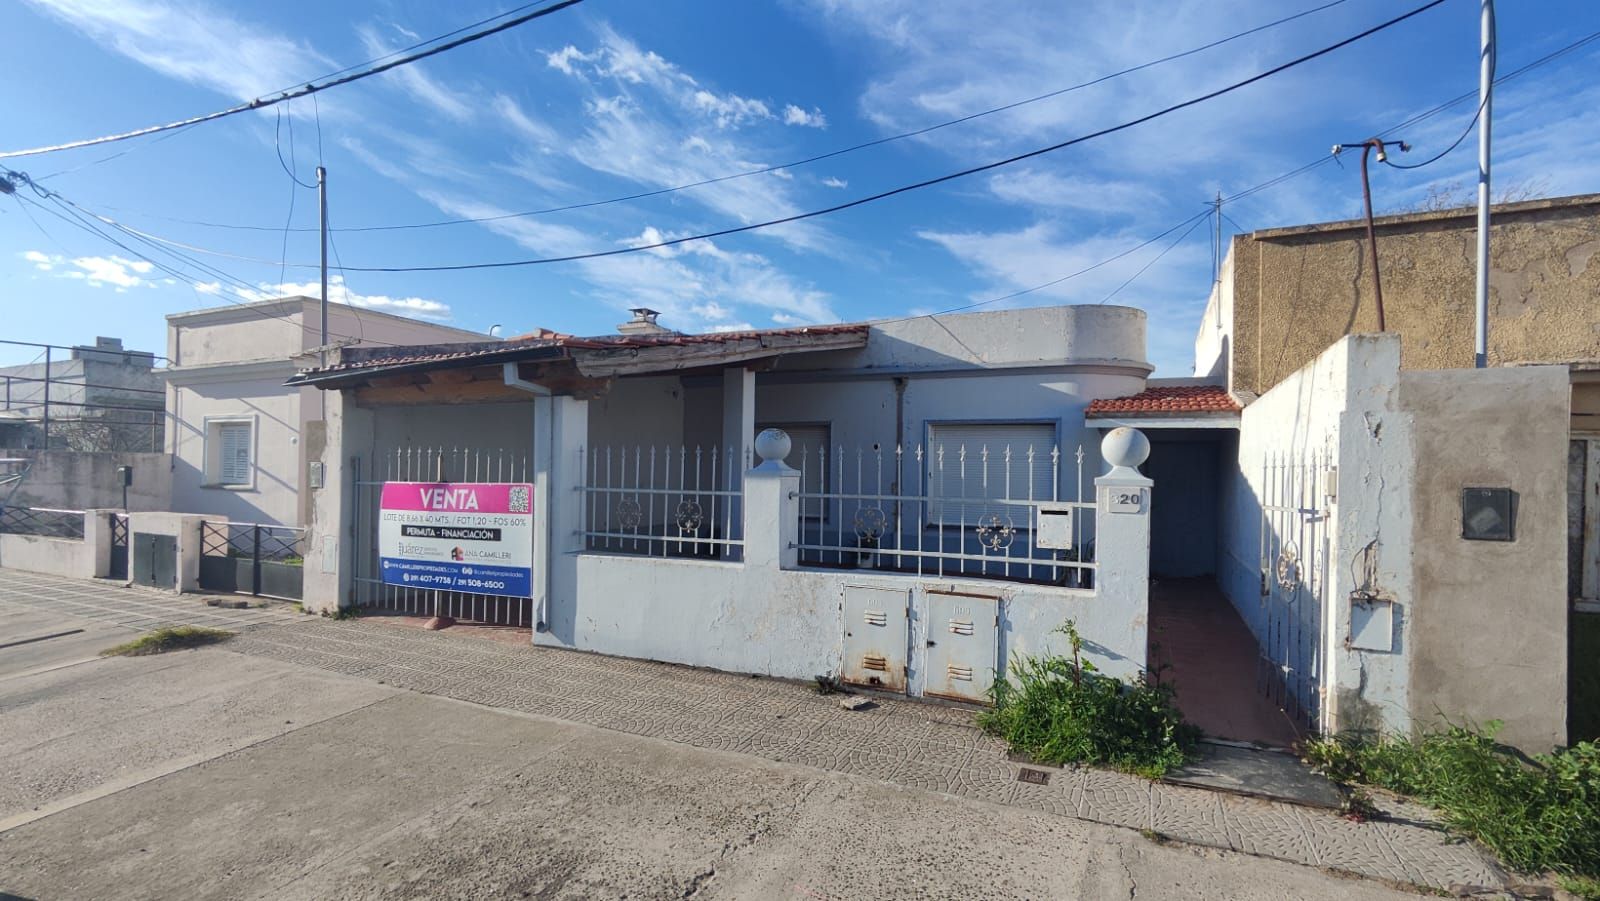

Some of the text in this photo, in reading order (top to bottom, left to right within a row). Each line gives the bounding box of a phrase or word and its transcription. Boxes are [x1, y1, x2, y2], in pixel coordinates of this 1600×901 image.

[420, 488, 479, 510] VENTA
[383, 513, 397, 522] LOTE
[398, 514, 405, 522] DE
[425, 515, 433, 524] 40
[457, 516, 471, 526] FOT
[493, 517, 508, 527] FOS
[510, 518, 526, 527] 60%
[407, 526, 435, 537] PERMUTA
[441, 528, 494, 539] FINANCIACIÓN
[479, 550, 512, 560] CAMILLERI
[468, 579, 505, 589] 508-6500
